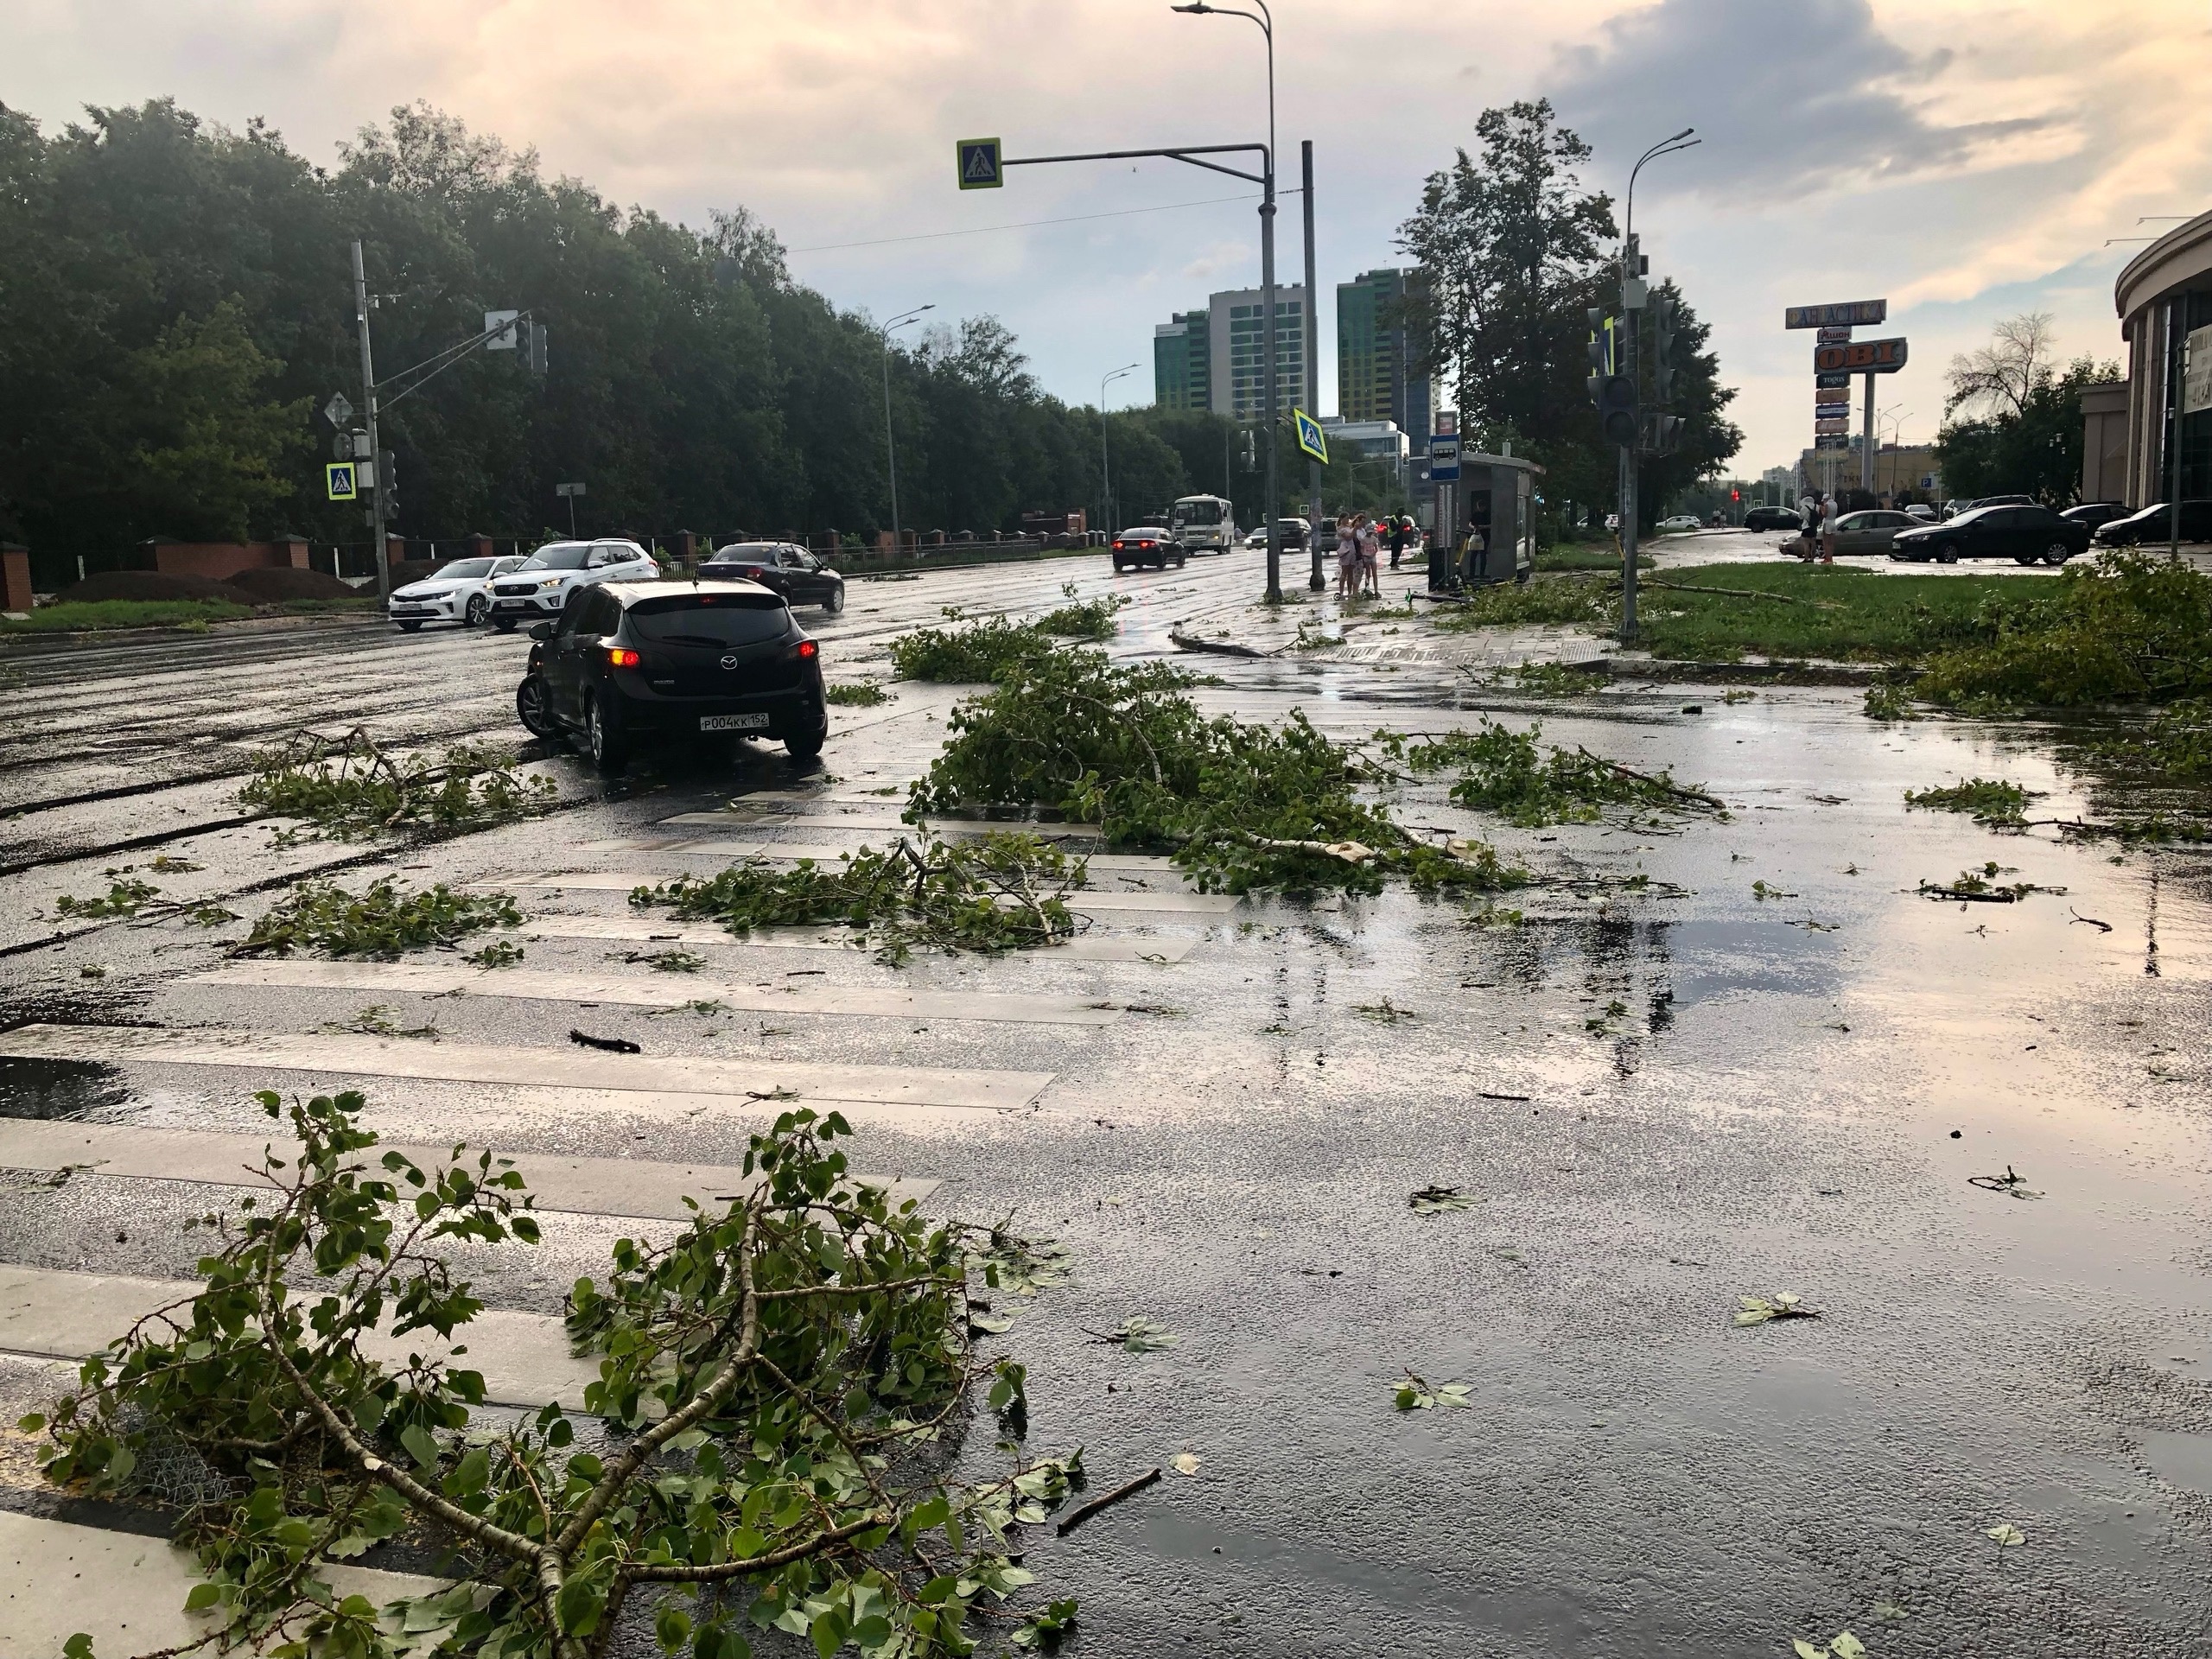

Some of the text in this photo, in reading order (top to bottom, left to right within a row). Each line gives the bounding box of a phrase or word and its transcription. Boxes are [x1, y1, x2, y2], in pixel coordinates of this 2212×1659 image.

[1789, 303, 1884, 325] ФАНТАСТИКА
[1818, 341, 1897, 370] OBI
[750, 714, 766, 723] 152
